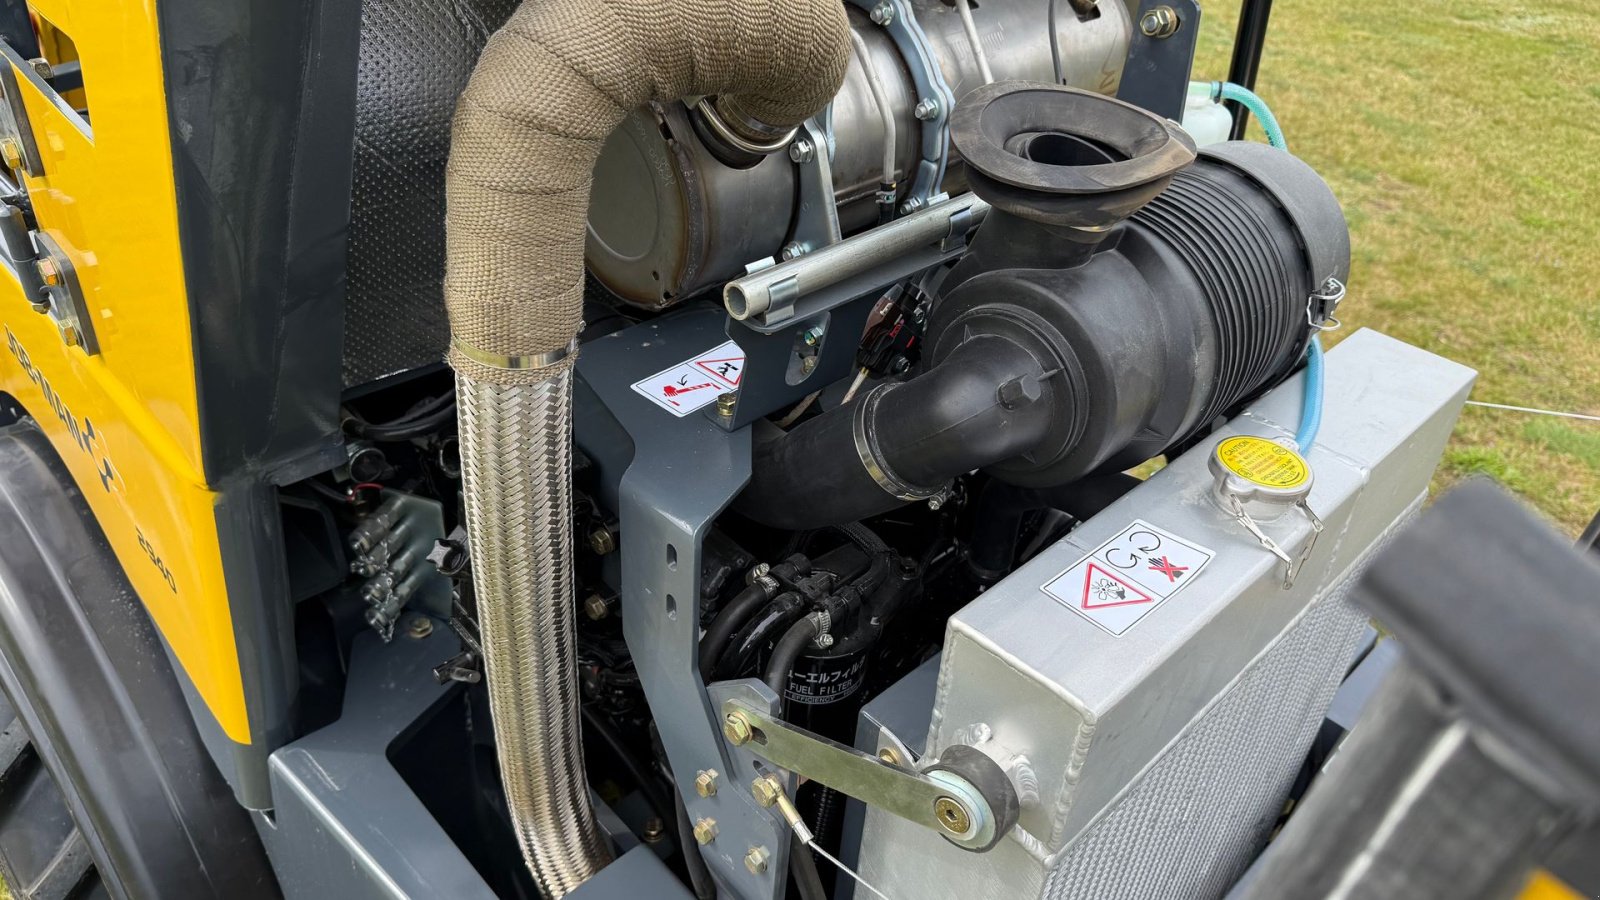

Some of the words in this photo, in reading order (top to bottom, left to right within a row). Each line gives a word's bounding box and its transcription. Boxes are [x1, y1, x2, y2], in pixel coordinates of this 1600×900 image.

[1224, 440, 1250, 456] CAUTION
[135, 525, 177, 595] 2940
[790, 683, 813, 695] FUEL
[819, 679, 853, 695] FILTER
[791, 695, 836, 703] EFFICIENCY
